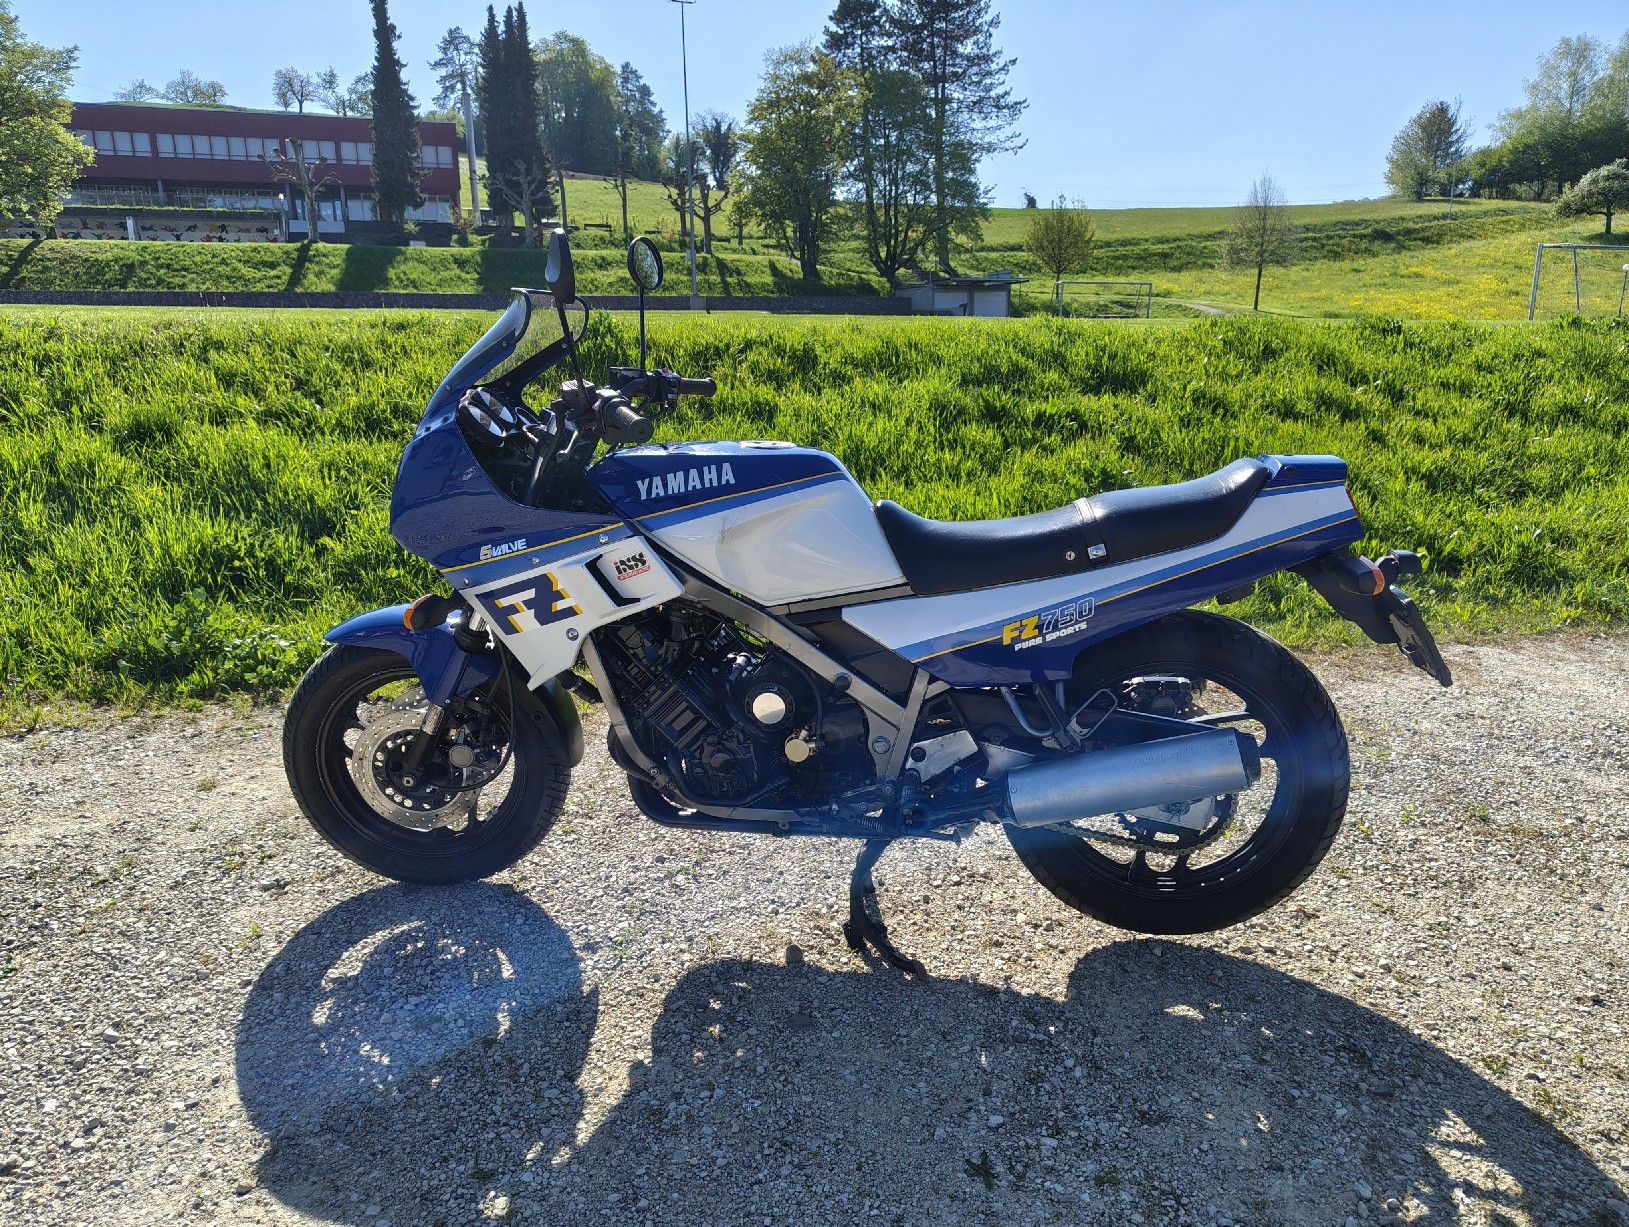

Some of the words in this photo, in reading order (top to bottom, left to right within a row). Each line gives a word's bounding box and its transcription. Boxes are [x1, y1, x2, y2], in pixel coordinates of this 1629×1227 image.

[636, 462, 735, 500] YAMAHA
[473, 571, 585, 636] FZ
[1014, 636, 1043, 652] PURE
[1045, 621, 1088, 642] SPORTS
